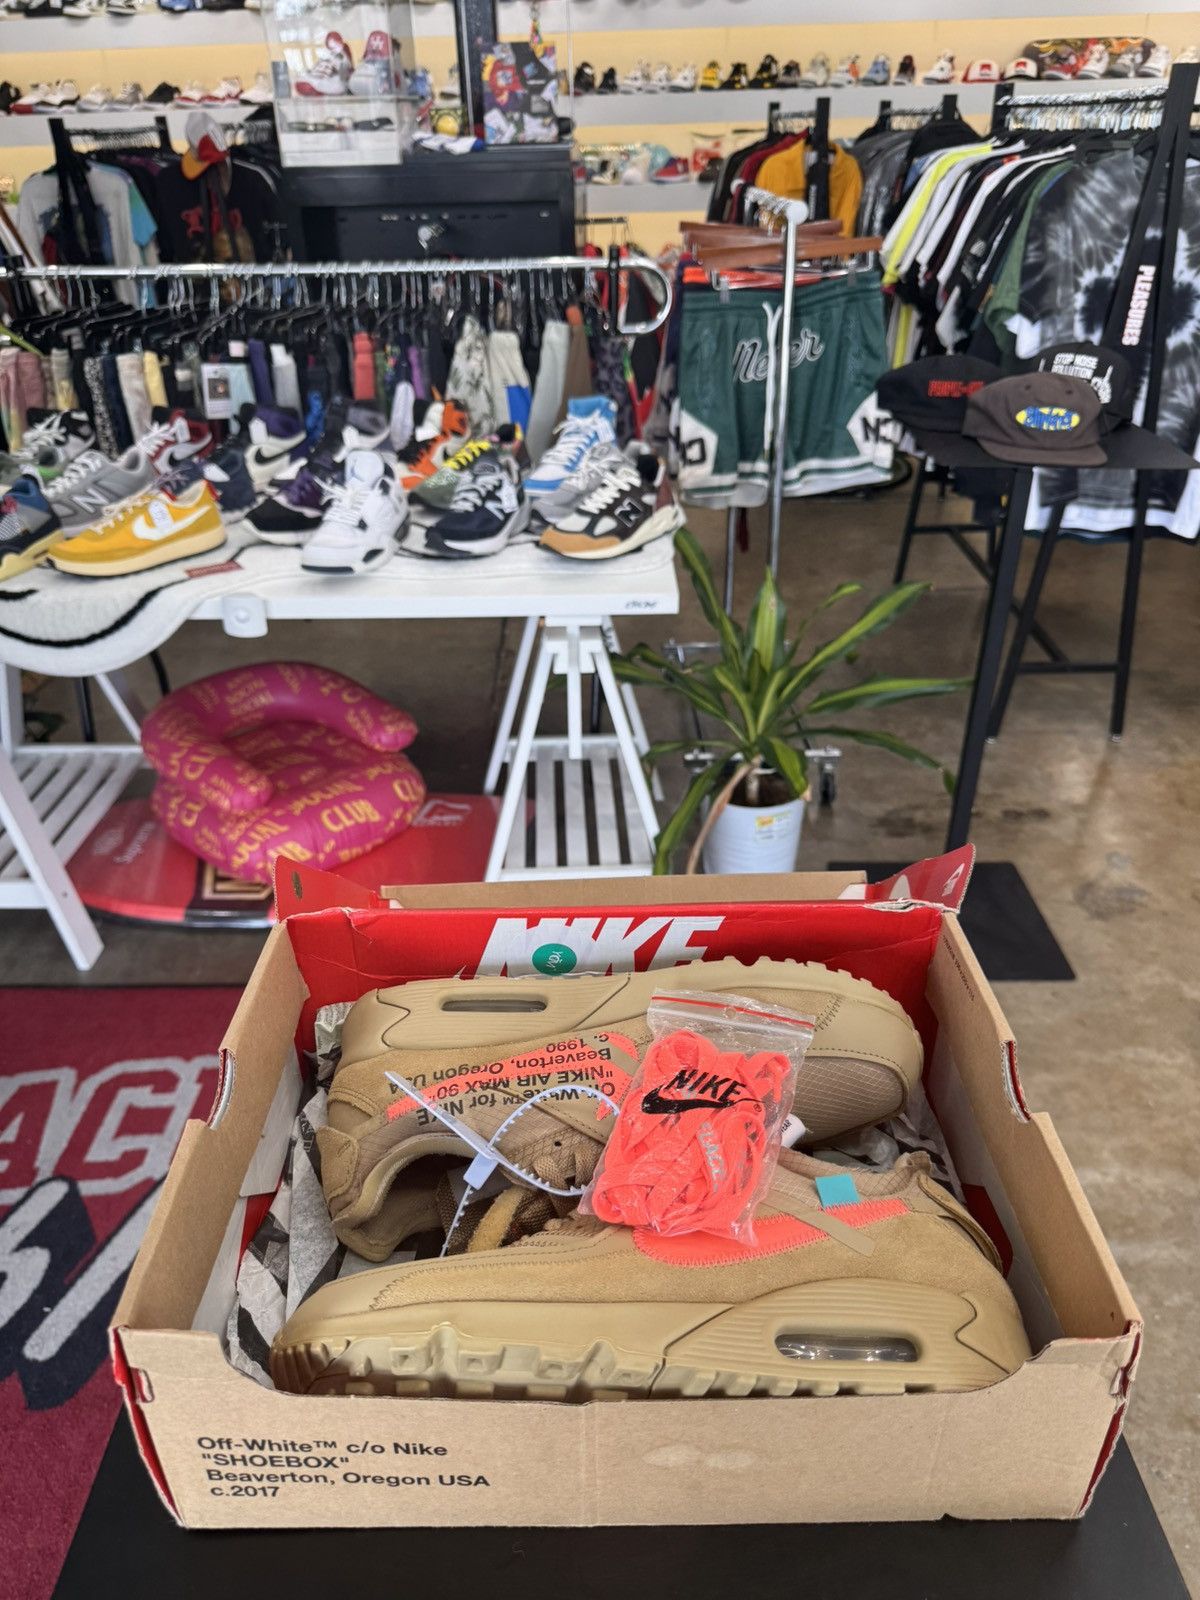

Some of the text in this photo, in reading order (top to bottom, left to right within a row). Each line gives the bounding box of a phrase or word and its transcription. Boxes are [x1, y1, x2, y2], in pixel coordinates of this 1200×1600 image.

[1121, 264, 1156, 346] PLEASURES
[733, 327, 825, 383] Neer
[321, 799, 381, 832] CLUB
[545, 1038, 588, 1054] 1990
[389, 1047, 613, 1096] Beaverton, Oregon UA
[516, 1072, 551, 1088] AIR
[558, 1065, 614, 1084] "NIKE
[465, 1075, 511, 1090] MAX
[662, 1068, 747, 1104] NIKE
[469, 1093, 499, 1108] for
[346, 1441, 386, 1455] c/o
[393, 1442, 449, 1457] Nike
[201, 1453, 350, 1469] "SHOEBOX"
[206, 1469, 491, 1488] Beaverton, Oregon USA
[210, 1485, 280, 1498] c.2017
